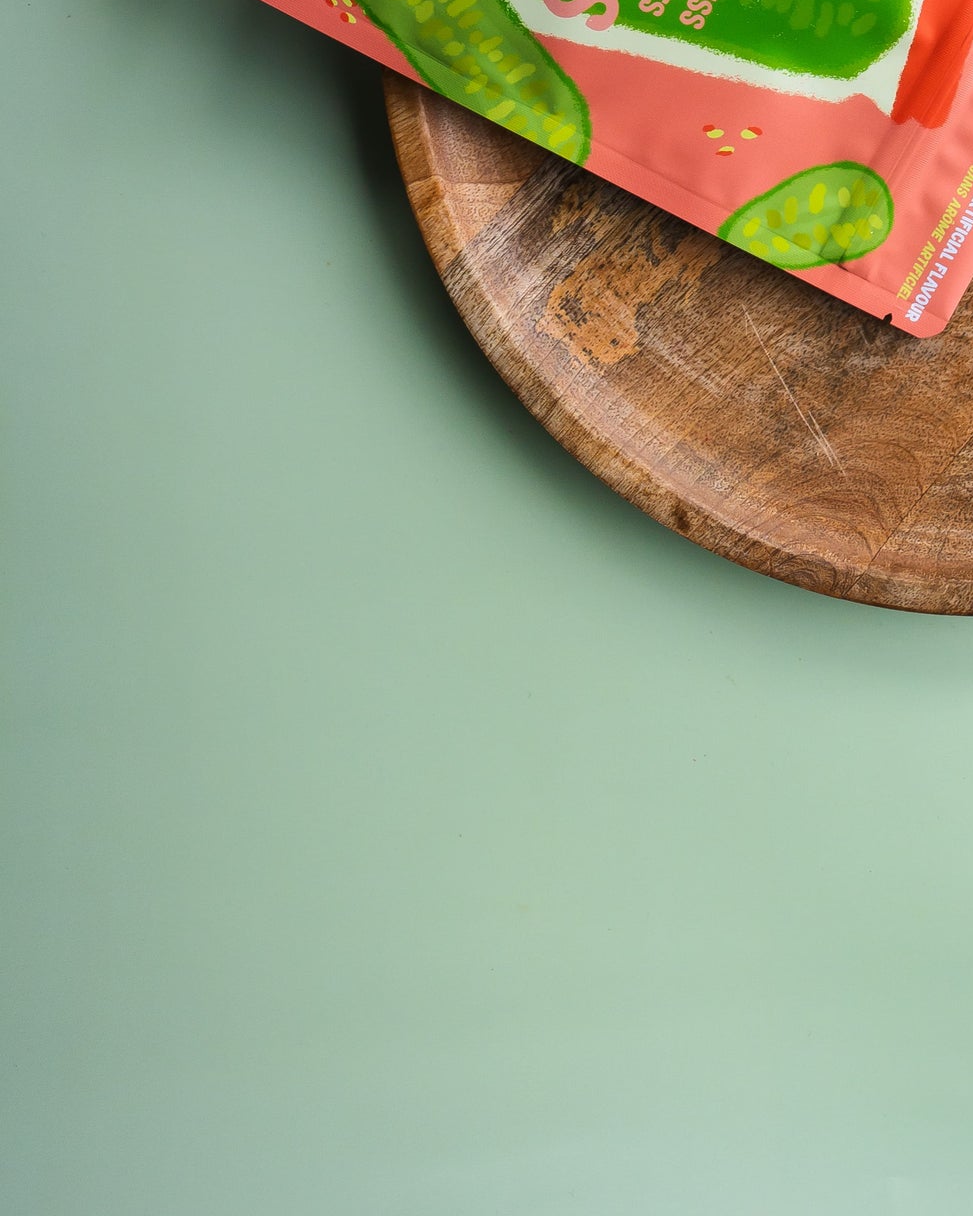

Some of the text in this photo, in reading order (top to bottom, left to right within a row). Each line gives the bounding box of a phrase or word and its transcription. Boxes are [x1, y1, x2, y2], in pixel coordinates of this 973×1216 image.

[930, 197, 962, 242] ARÔME
[896, 240, 937, 301] ARTIFICIEL
[904, 259, 948, 323] FLAVOUR
